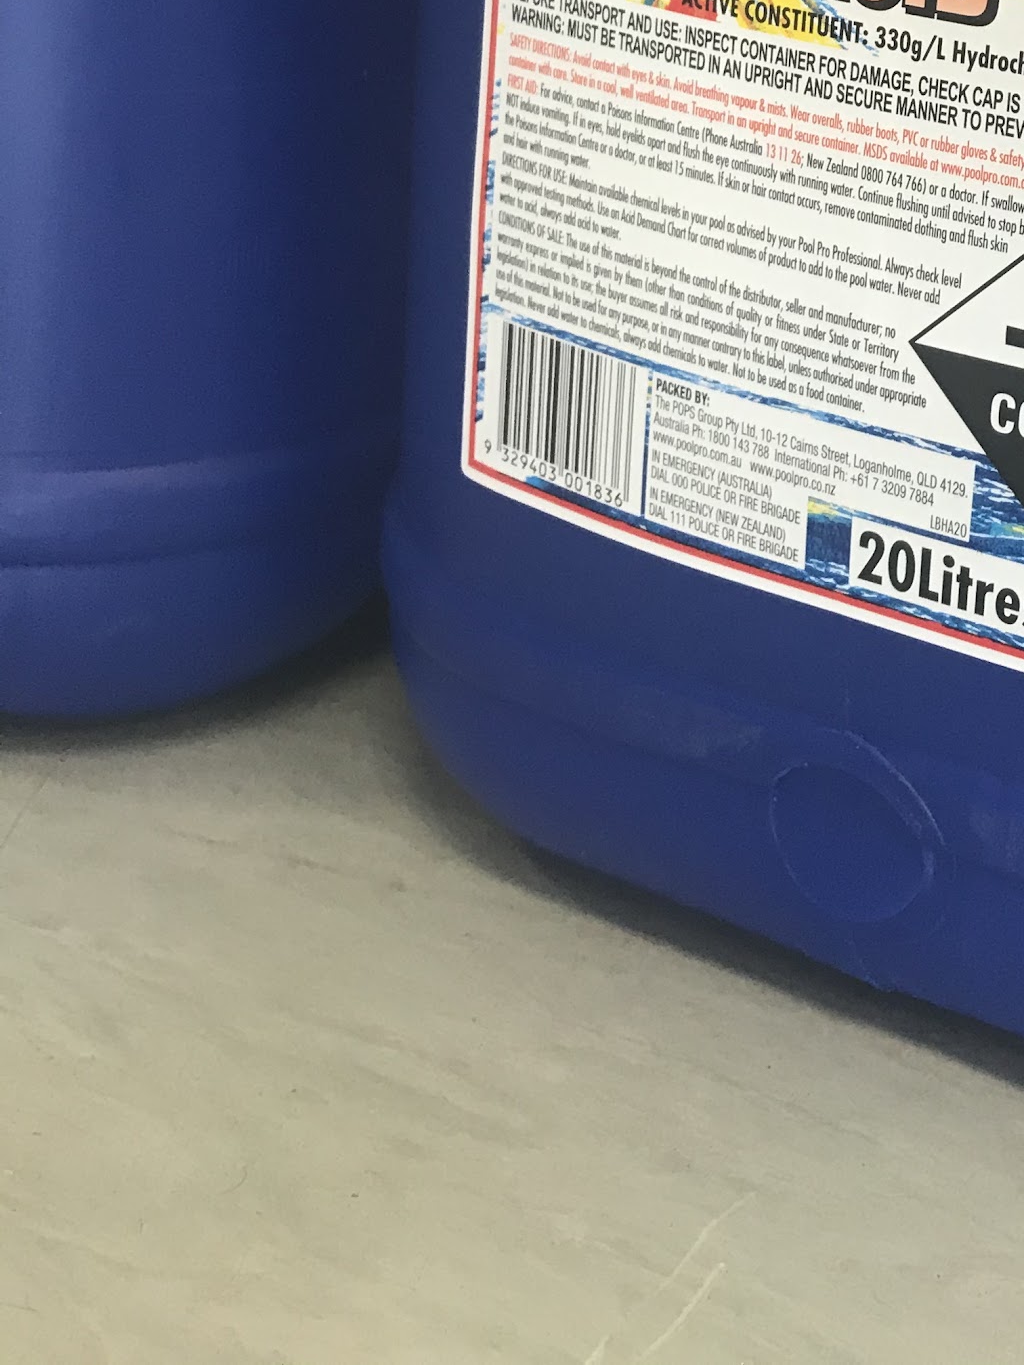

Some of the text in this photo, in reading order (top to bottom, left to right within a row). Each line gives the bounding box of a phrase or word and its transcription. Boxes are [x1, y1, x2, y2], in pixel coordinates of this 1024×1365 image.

[627, 12, 652, 34] AND
[655, 18, 682, 42] USE:
[685, 25, 738, 55] INSPECT
[740, 38, 816, 73] CONTAINER
[819, 55, 847, 80] FOR
[850, 61, 914, 97] DAMAGE,
[918, 75, 970, 104] CHECK
[972, 86, 1004, 110] CAP
[1006, 92, 1021, 114] IS
[744, 0, 869, 46] CONSTITUENT:
[874, 25, 946, 62] 330g/L
[512, 3, 565, 35] WARNING:
[567, 18, 599, 43] MUST
[600, 27, 616, 48] BE
[618, 31, 705, 71] TRANSPORTED
[708, 54, 721, 75] IN
[723, 58, 742, 80] AN
[744, 62, 802, 93] UPRIGHT
[803, 76, 833, 100] AND
[836, 83, 893, 113] SECURE
[896, 95, 958, 127] MANNER
[962, 108, 982, 131] TO
[766, 143, 776, 159] 13
[779, 146, 788, 161] 11
[791, 149, 804, 168] 26;
[806, 152, 824, 170] New
[825, 157, 859, 179] Zealand
[860, 165, 884, 184] 0800
[885, 170, 903, 188] 764
[905, 174, 927, 195] 766)
[929, 184, 939, 196] or
[949, 184, 978, 205] doctor.
[981, 190, 990, 207] If
[863, 141, 888, 161] MSDS
[889, 149, 928, 170] available
[929, 158, 939, 172] at
[656, 378, 710, 407] PACKED BY:
[484, 440, 624, 507] 9 329403 001836
[651, 449, 772, 501] IN EMERGENCY (AUSTRALIA)
[653, 411, 934, 507] Australia Ph: 1800 143 788 International Ph: +61 7 3209 7884
[653, 430, 836, 496] www.poolpro.com.au www.poolpro.co.nz
[655, 394, 968, 498] The POPS Group Pty Ltd, 10-12 Cairns Street, Loganholme, QLD 4129.
[650, 465, 801, 525] DIAL 000 POLICE OR FIRE BRIGADE
